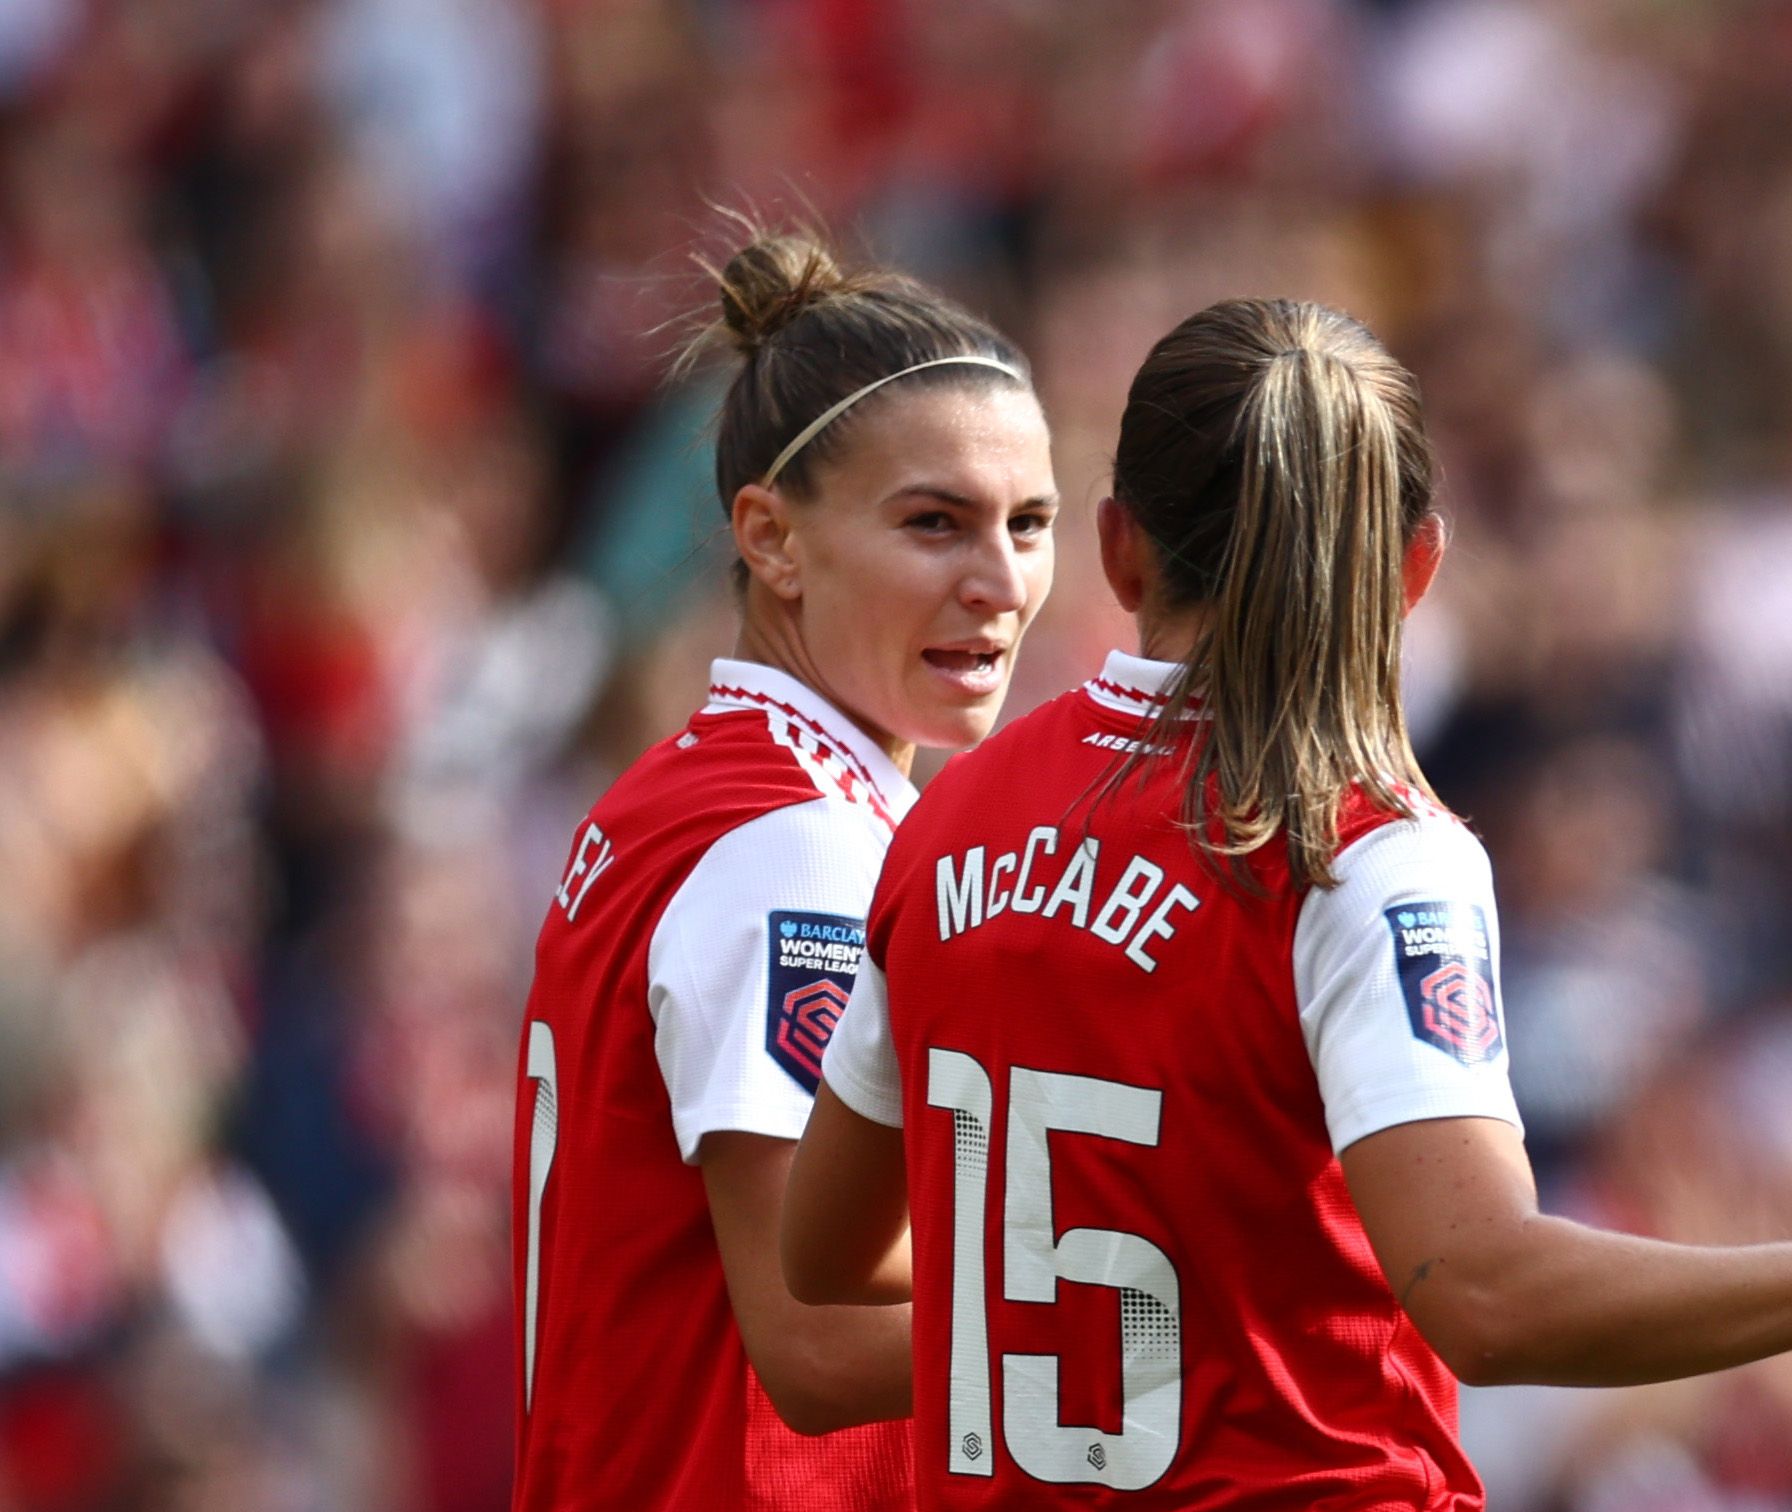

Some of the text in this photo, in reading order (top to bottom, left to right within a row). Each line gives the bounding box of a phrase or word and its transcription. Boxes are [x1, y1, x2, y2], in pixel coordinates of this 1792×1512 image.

[556, 823, 614, 922] EY
[936, 826, 1199, 973] McCABE
[780, 939, 861, 962] WOMEN'
[800, 923, 865, 944] BARCLAY
[780, 955, 859, 975] SUPER LEAG
[928, 1048, 1181, 1491] 15
